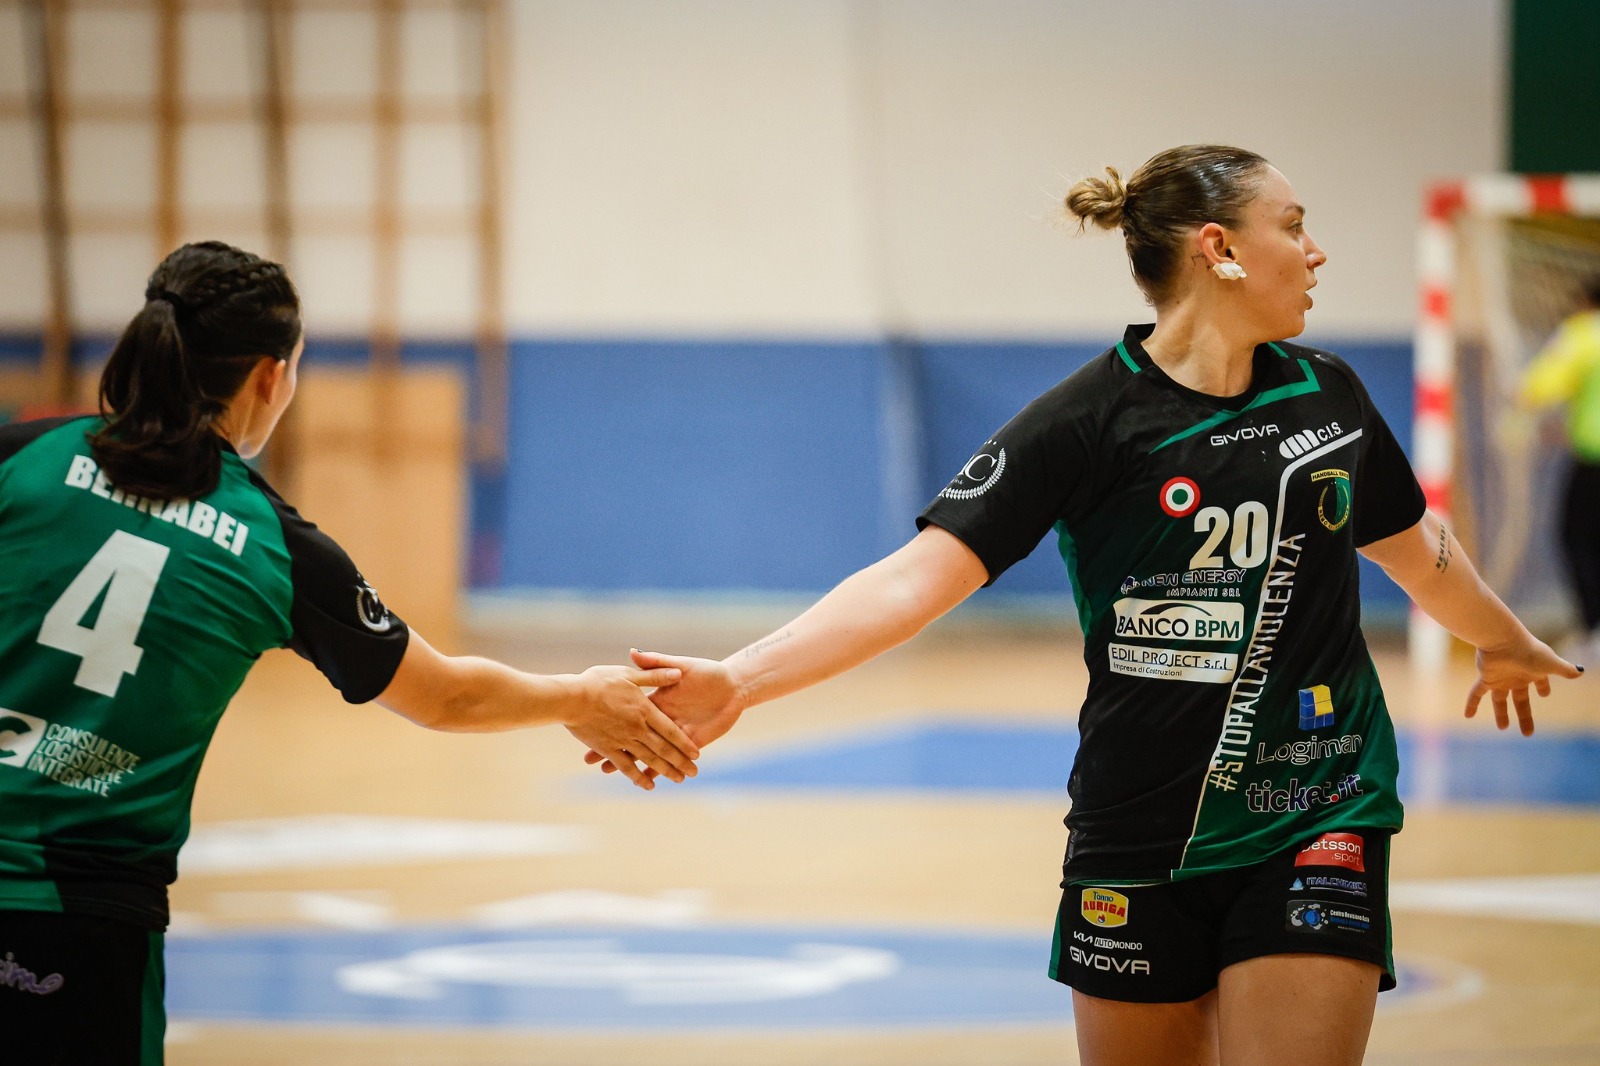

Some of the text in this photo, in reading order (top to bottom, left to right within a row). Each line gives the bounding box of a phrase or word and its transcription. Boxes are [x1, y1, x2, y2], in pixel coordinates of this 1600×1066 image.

[1210, 424, 1280, 446] GIVOVA
[1317, 421, 1344, 442] C.I.S.
[65, 454, 249, 557] BEABEI
[1188, 501, 1269, 570] 20
[1141, 569, 1247, 587] NEW ENERGY
[1221, 587, 1241, 597] SRL
[36, 529, 170, 698] 4
[1117, 616, 1240, 638] BANCO BPM
[1111, 647, 1138, 662] EDIL
[1142, 651, 1202, 668] PROJECT
[1113, 662, 1137, 673] Impresa
[1138, 665, 1145, 673] di
[1208, 533, 1306, 791] #STOPALLAVIOLENZA
[27, 753, 110, 798] INTEGRATE
[1245, 773, 1364, 813] ticket.it
[1301, 838, 1361, 855] etsson
[1083, 901, 1126, 918] AURIGA
[1069, 945, 1150, 975] GIVOVA
